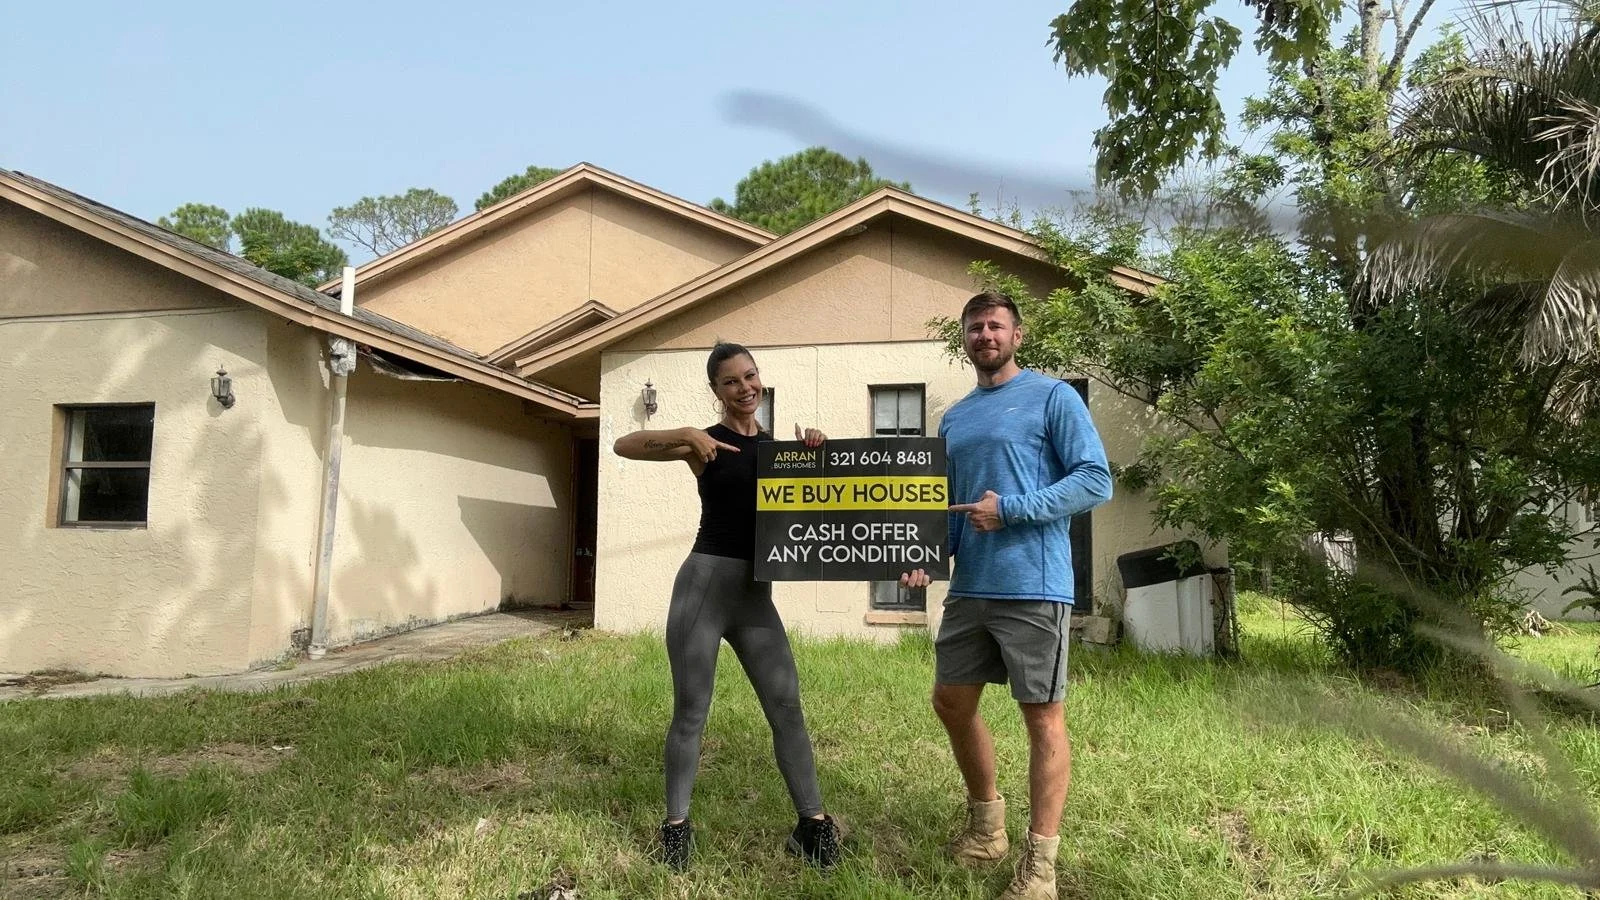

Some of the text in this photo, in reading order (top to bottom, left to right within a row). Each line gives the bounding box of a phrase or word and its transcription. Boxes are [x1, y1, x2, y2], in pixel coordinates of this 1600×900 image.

[774, 451, 816, 462] ARRAN
[830, 451, 932, 466] 321 604 8481
[761, 483, 945, 504] WE BUY HOUSES
[788, 523, 920, 541] CASH OFFER
[767, 544, 940, 563] ANY CONDITION
